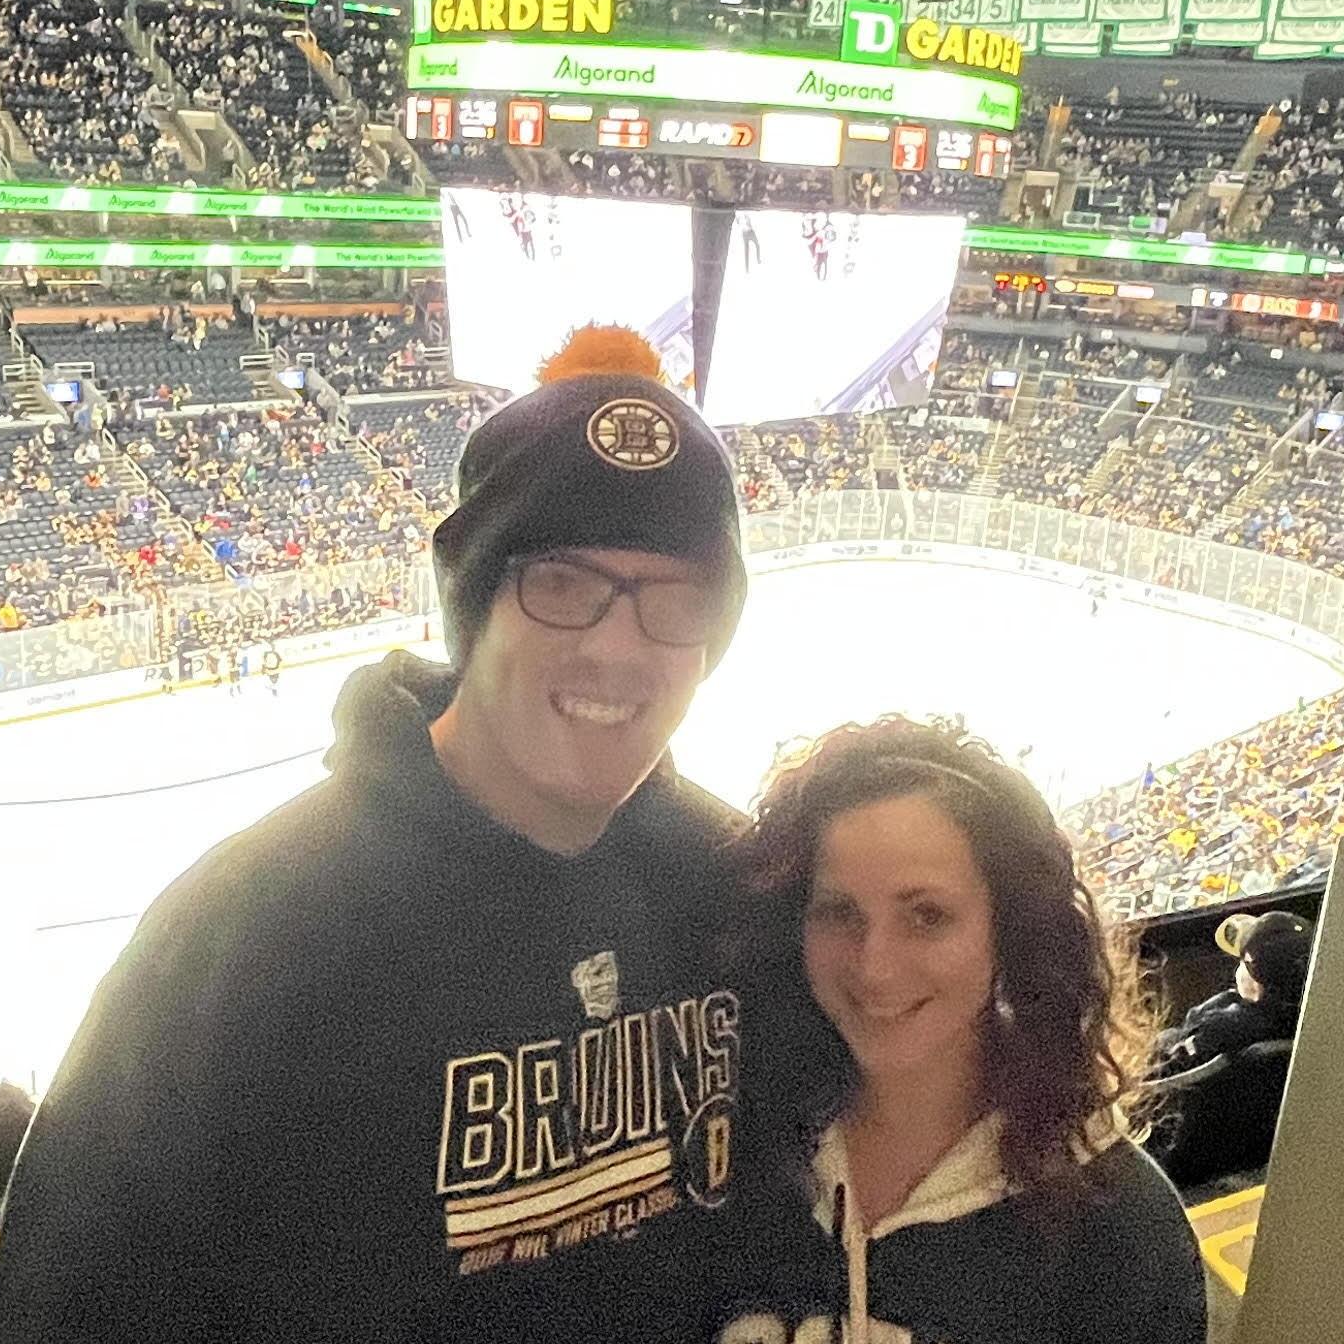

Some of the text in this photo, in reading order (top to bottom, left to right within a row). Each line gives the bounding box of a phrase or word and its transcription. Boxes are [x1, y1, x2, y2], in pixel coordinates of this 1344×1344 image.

[814, 2, 835, 22] 24
[849, 11, 1022, 75] TD GARDEN
[554, 56, 895, 102] Algorand Algorand
[437, 990, 741, 1194] BRUINS
